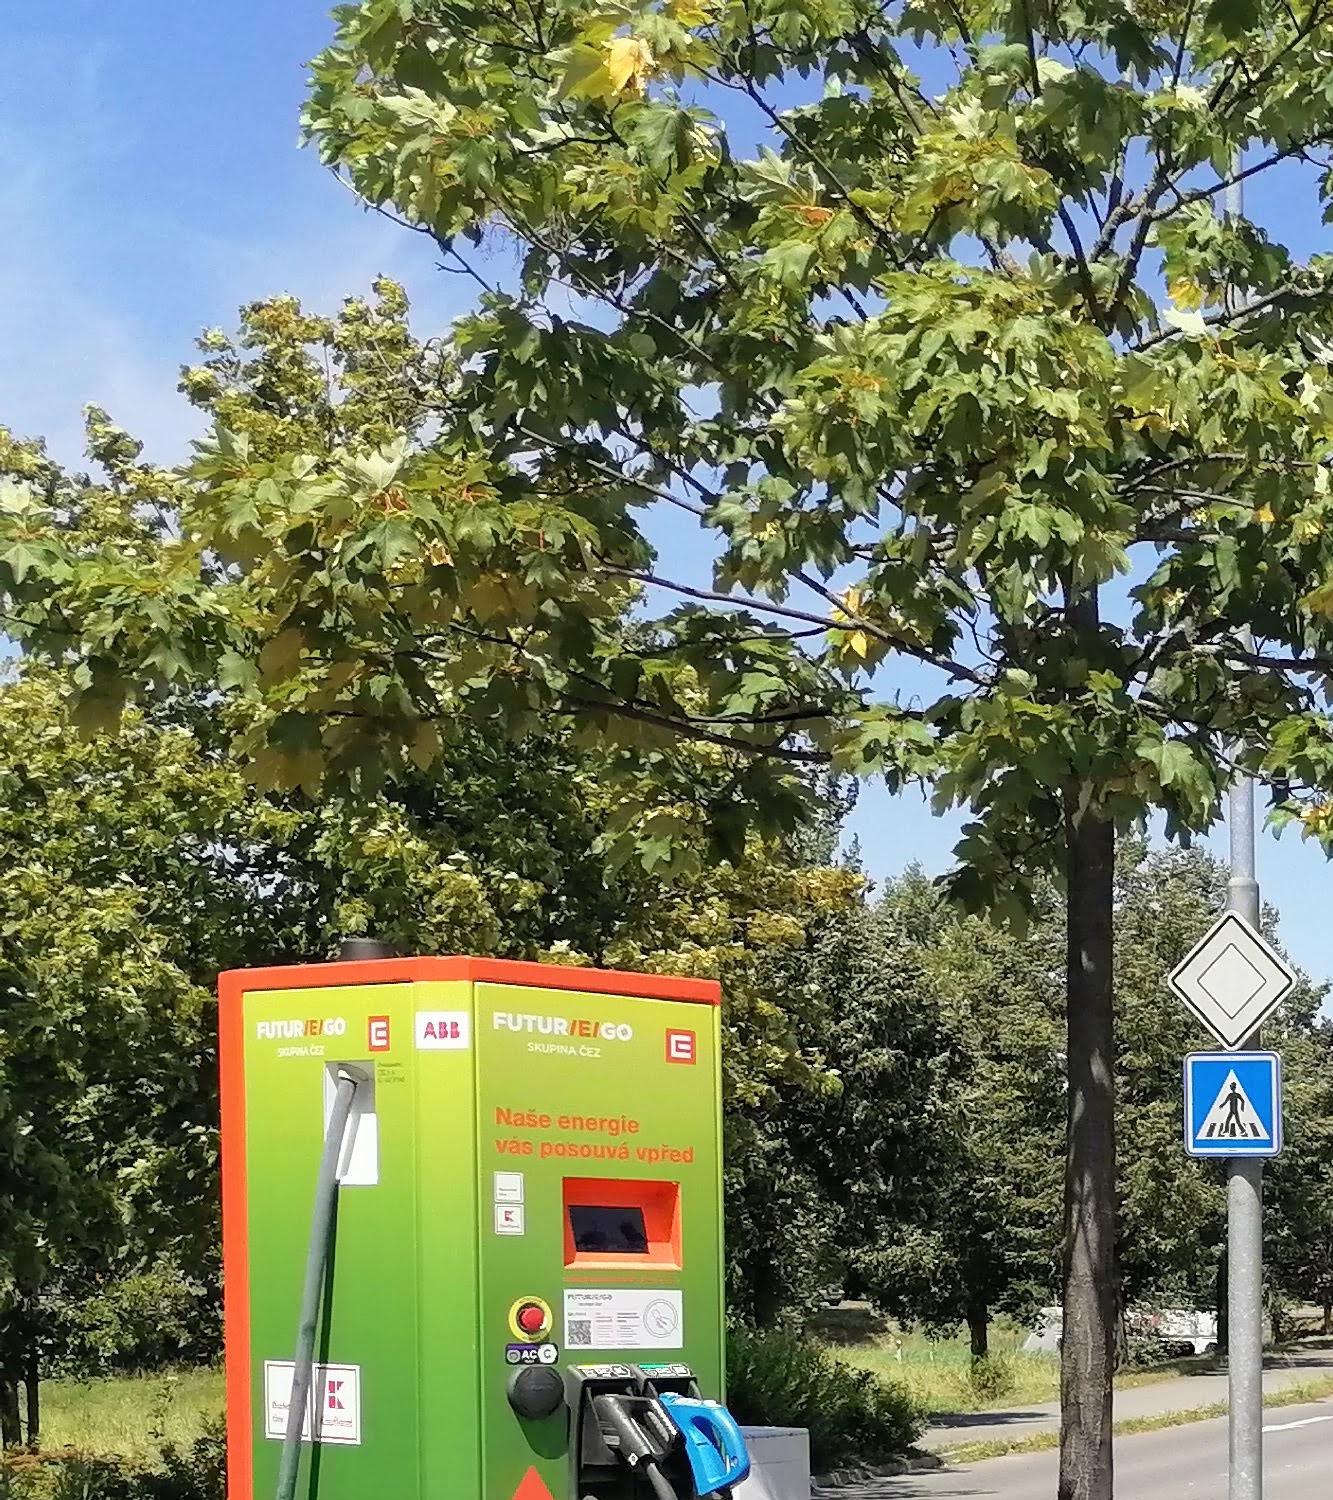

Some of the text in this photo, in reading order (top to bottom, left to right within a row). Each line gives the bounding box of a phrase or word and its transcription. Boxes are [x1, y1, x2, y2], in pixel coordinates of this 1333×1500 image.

[424, 1021, 460, 1039] ABB
[527, 1042, 602, 1058] SKUPINA ČEZ
[495, 1106, 640, 1136] Naše energie
[495, 1136, 694, 1164] vás posouvá vpřed
